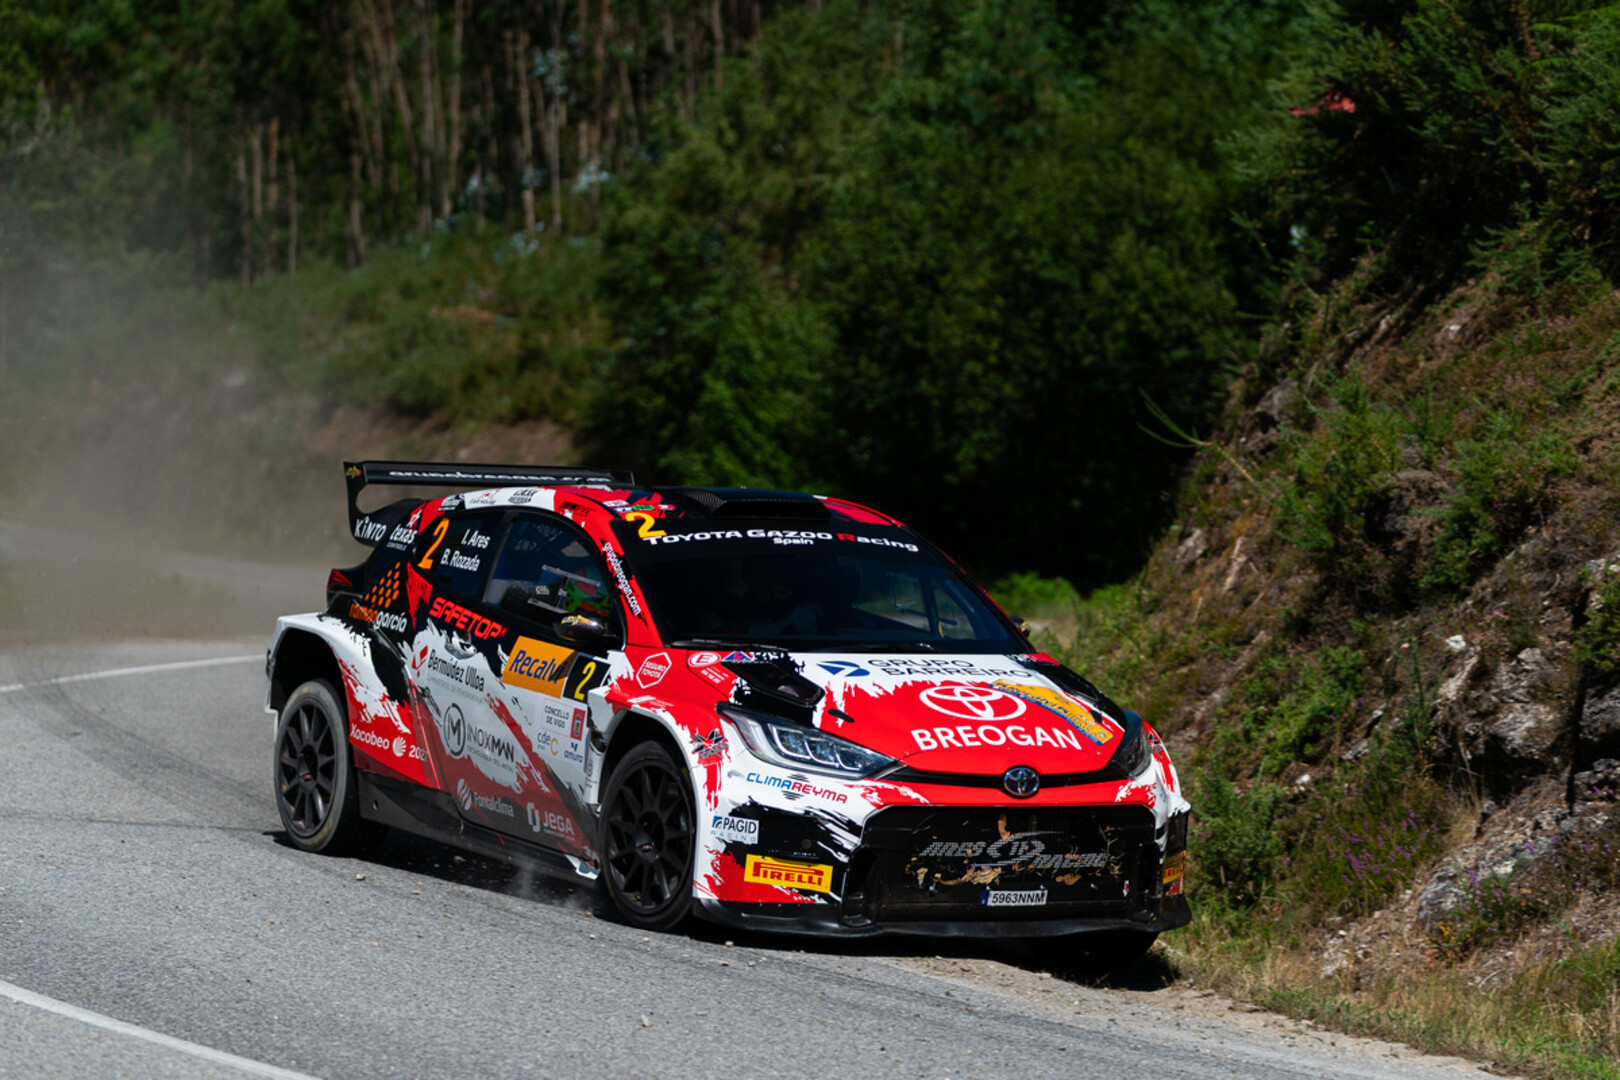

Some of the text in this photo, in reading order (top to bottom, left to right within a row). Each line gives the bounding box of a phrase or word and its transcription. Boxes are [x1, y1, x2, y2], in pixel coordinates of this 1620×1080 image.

[625, 512, 667, 538] 2
[418, 518, 449, 570] 2
[468, 530, 491, 549] Ares
[642, 529, 919, 552] TOYOTA GAZOO Racing
[773, 537, 814, 546] Spain
[440, 548, 481, 572] B. Rozada
[601, 541, 642, 616] grupobreogan.com
[429, 596, 505, 640] SAFETOP
[428, 649, 465, 683] Bermúdez
[465, 665, 485, 692] Ulloa
[509, 649, 568, 685] Recalvi
[868, 659, 974, 668] GRUPO
[881, 667, 1032, 678] BARREIRO
[574, 661, 597, 701] 2
[544, 705, 570, 720] CONCELLO
[546, 715, 566, 728] DE VIGO
[350, 723, 390, 750] Xacobeo
[467, 723, 515, 762] INOXMAN
[911, 725, 1082, 751] BREOGAN
[746, 772, 848, 804] CLIMAREYMA
[710, 830, 757, 842] RACING
[723, 817, 757, 834] PAGID
[752, 861, 824, 887] PIRELLI
[992, 892, 1046, 904] 5963NNM
